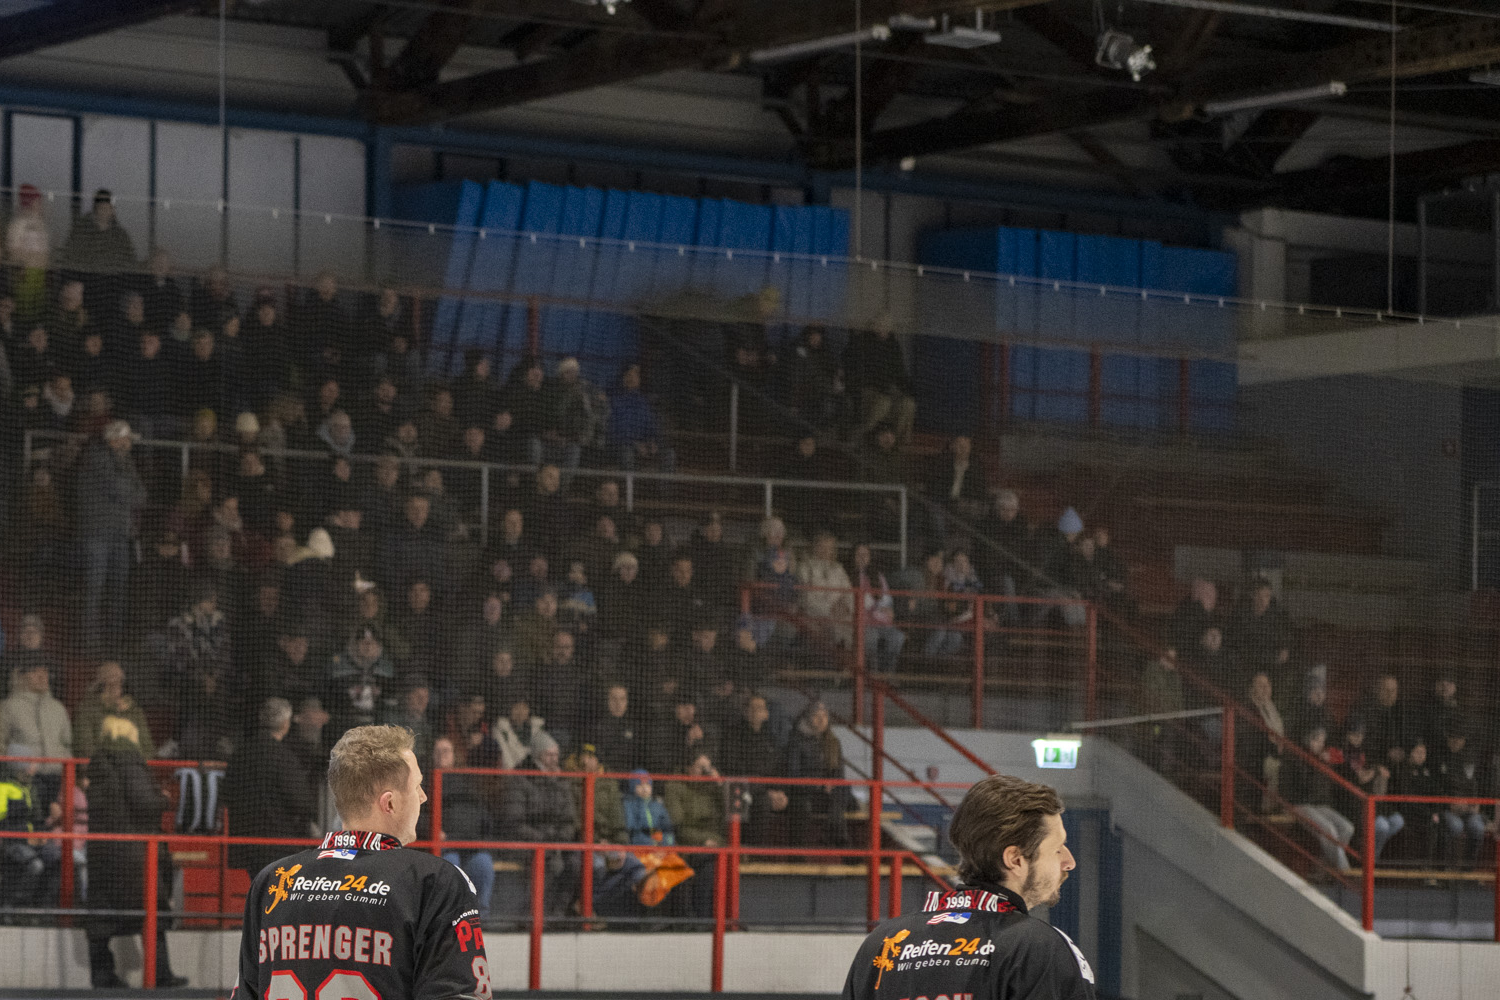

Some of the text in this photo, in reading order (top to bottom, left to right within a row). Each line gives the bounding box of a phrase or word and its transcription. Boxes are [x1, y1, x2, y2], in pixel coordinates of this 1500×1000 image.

[333, 834, 357, 847] 1996
[292, 875, 391, 896] Reifen24.de
[289, 893, 387, 907] Wir geben Gummi!
[946, 896, 972, 909] 1996
[259, 924, 393, 967] SPRENGER
[897, 962, 913, 972] Wir
[914, 959, 950, 970] geben
